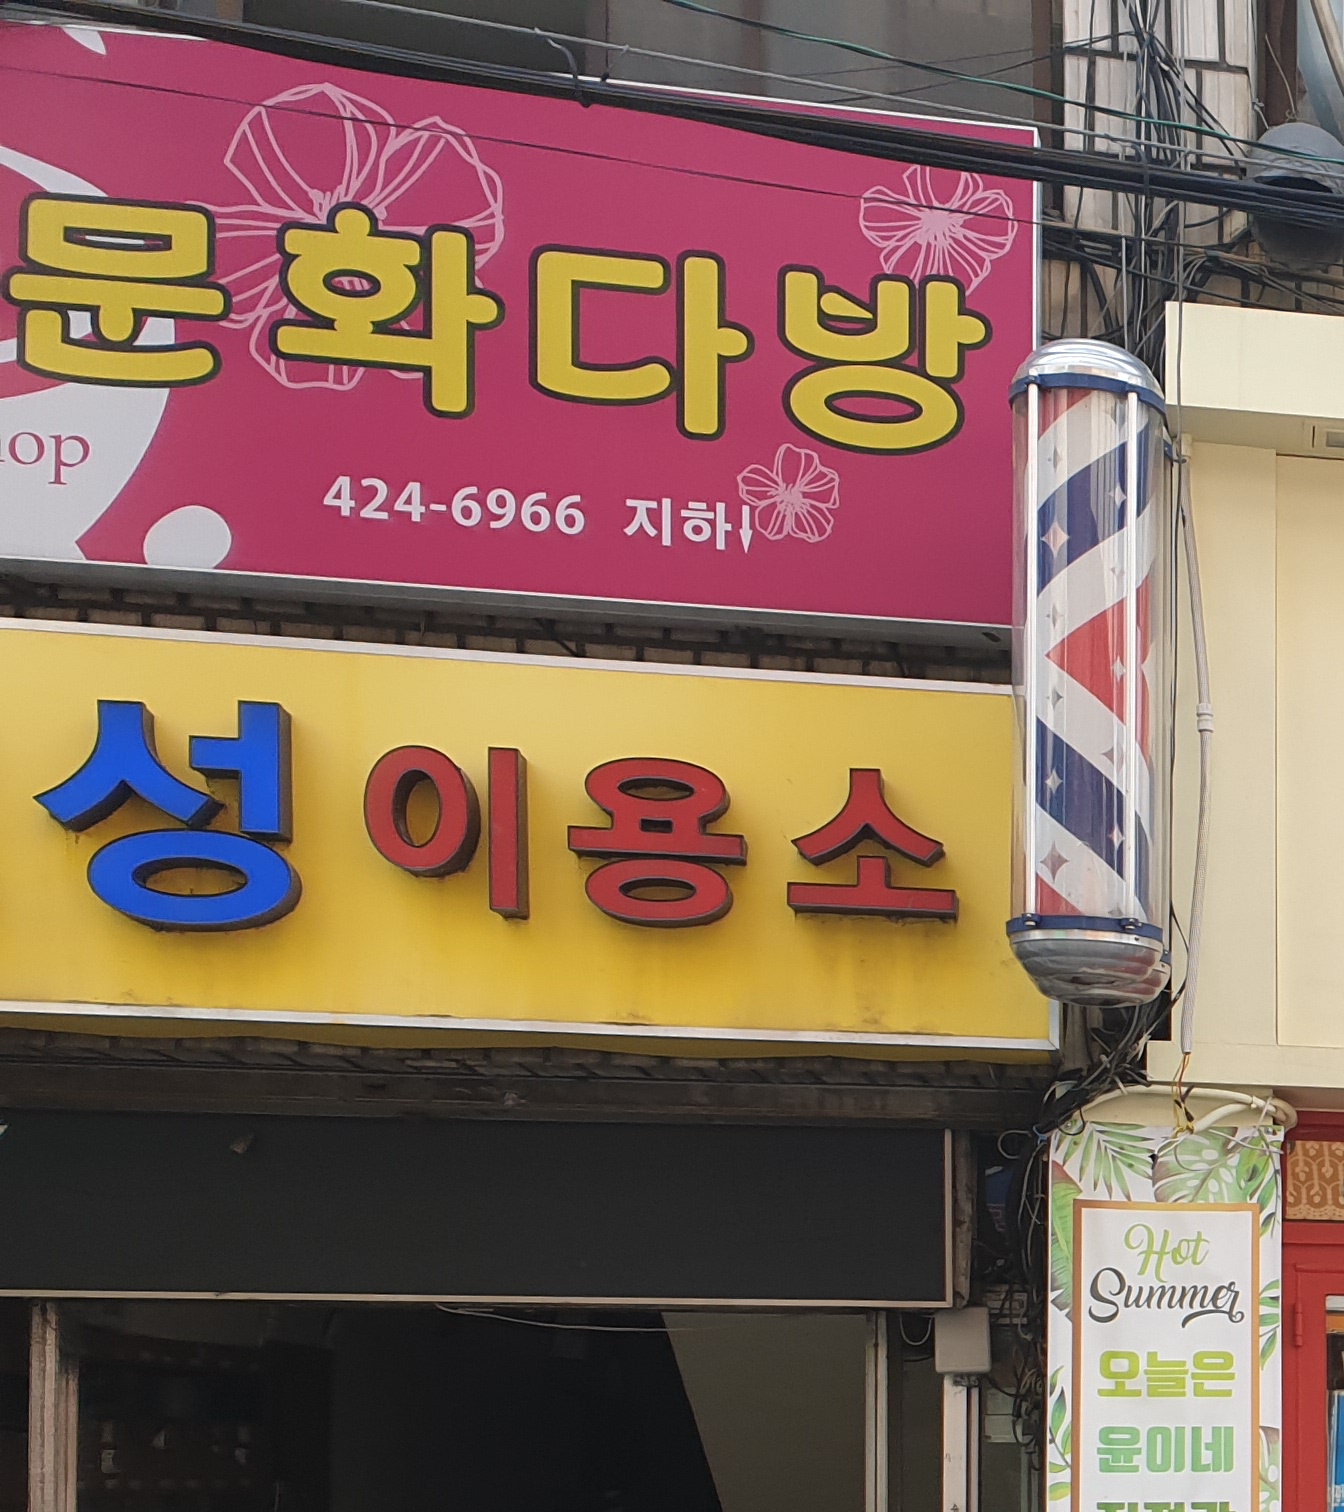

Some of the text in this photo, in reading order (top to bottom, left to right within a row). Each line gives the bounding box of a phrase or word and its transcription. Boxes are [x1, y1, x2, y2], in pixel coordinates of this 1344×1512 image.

[7, 192, 991, 454] 문화다방
[0, 431, 91, 485] op
[323, 474, 732, 551] 424-6966 지하
[362, 743, 959, 928] 이용소
[1124, 1223, 1211, 1283] Hot
[1088, 1267, 1246, 1329] Summer
[1097, 1350, 1237, 1398] 오늘은
[1096, 1426, 1235, 1474] 윤이네
